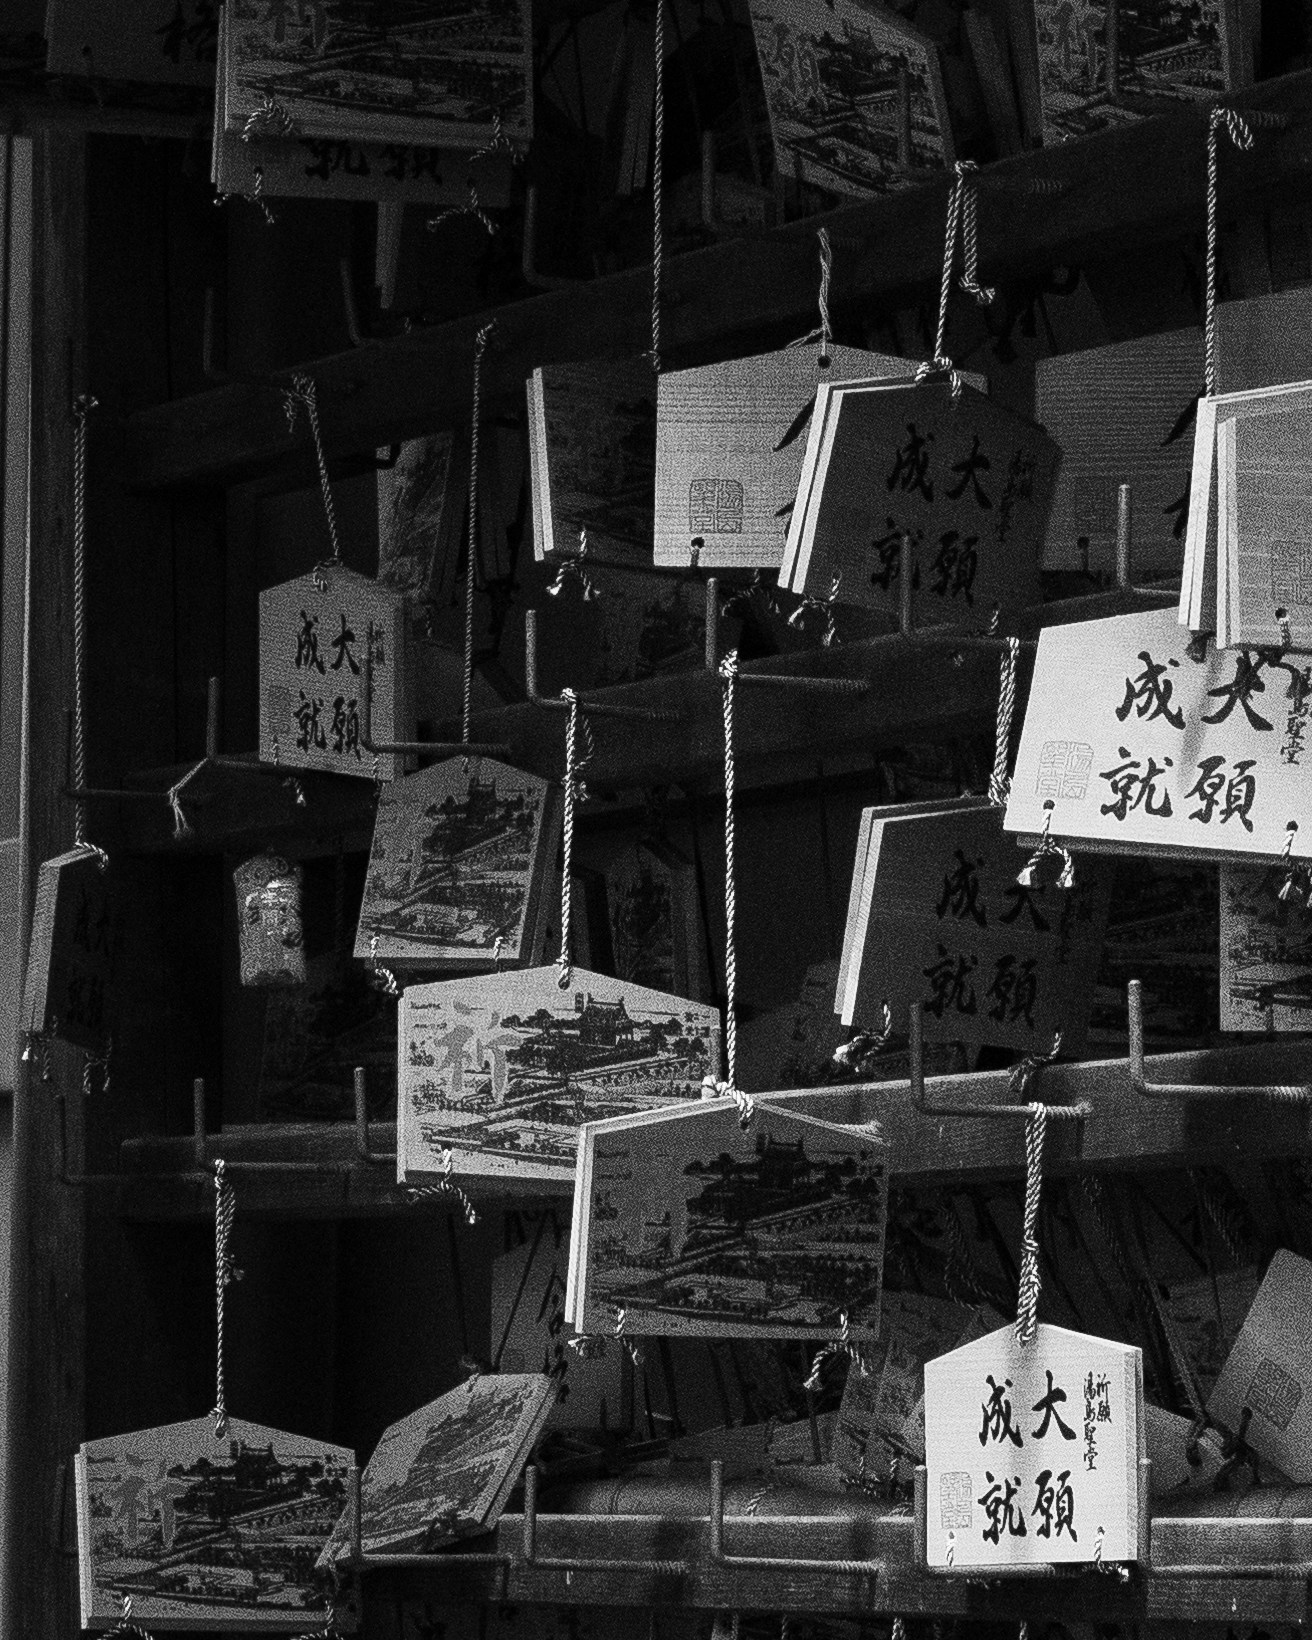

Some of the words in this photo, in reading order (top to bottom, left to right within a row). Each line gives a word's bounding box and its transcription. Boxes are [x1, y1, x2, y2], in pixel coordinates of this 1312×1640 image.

[872, 423, 934, 592] 成就
[931, 435, 992, 606] 大願
[293, 609, 327, 754] 成就
[331, 613, 362, 759] 大願
[1099, 650, 1186, 820] 成就
[1185, 651, 1275, 833] 大願
[924, 850, 988, 1017] 成就
[986, 877, 1050, 1028] 大願
[977, 1374, 1027, 1547] 成就
[1029, 1370, 1078, 1543] 大願
